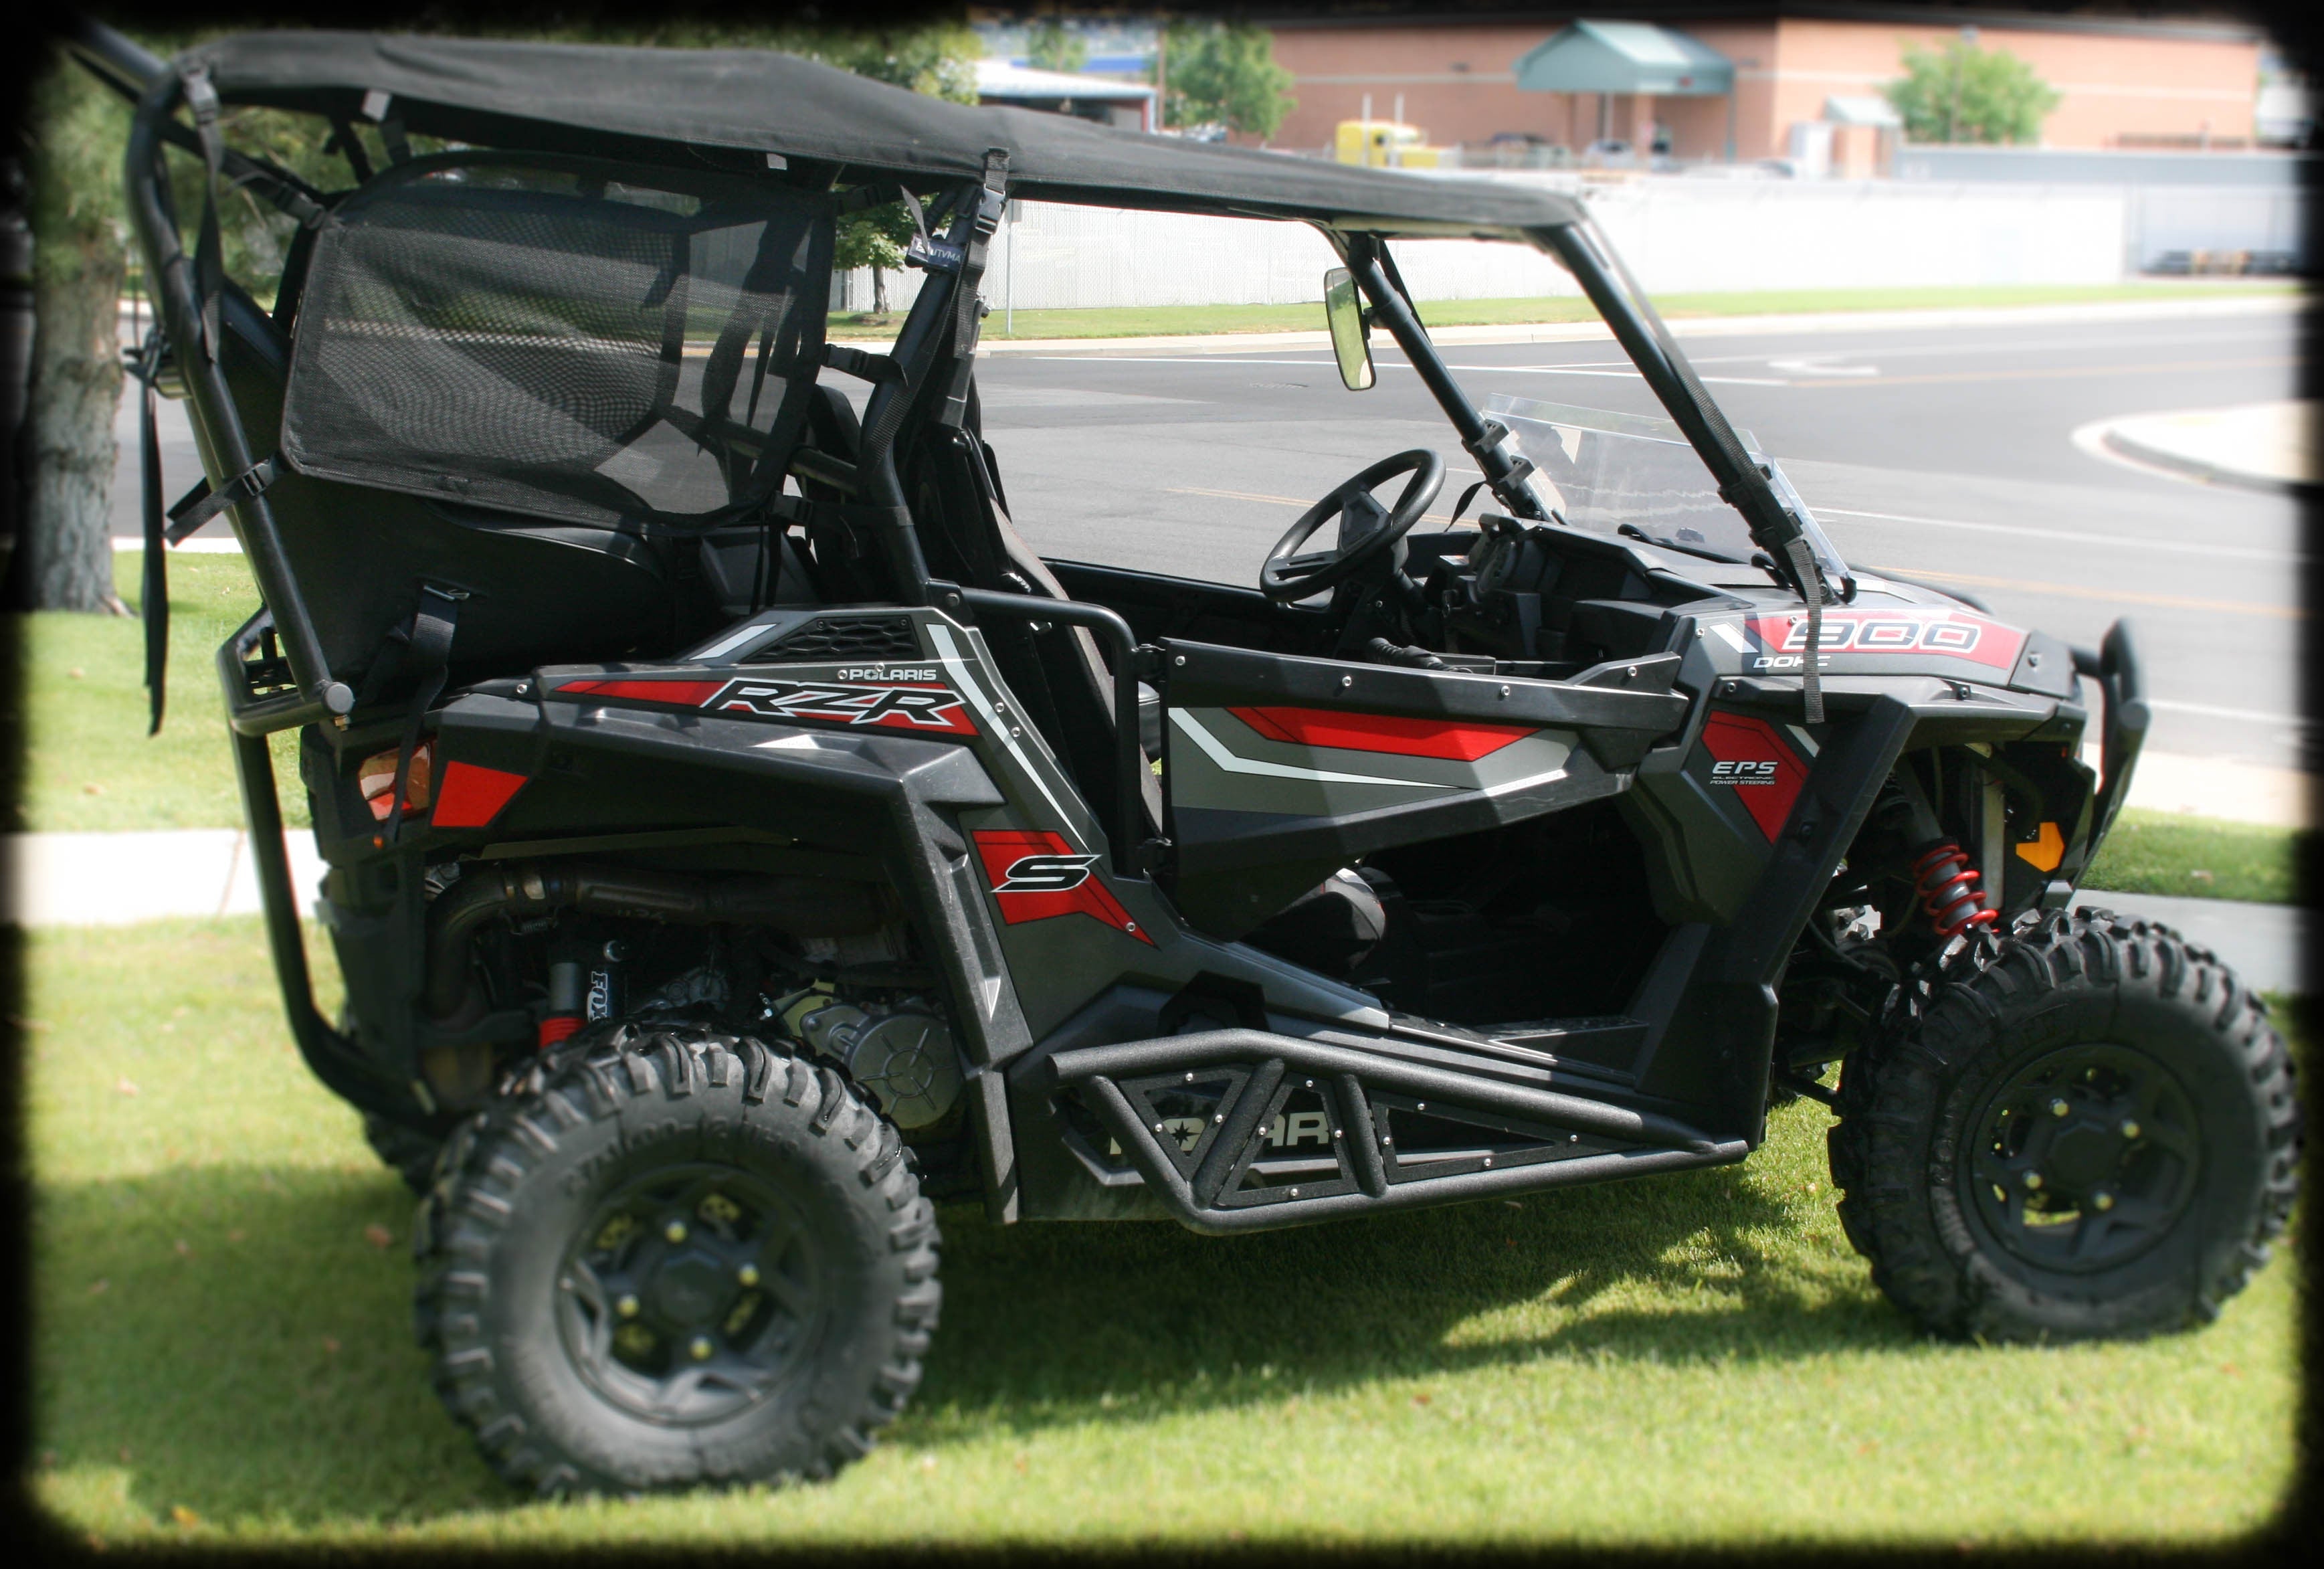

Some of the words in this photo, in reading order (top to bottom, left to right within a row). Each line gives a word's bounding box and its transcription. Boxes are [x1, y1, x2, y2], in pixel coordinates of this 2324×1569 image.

[1781, 619, 1982, 654] 900
[849, 669, 937, 680] POLARIS
[699, 676, 967, 727] RZR
[1712, 761, 1778, 774] EPS
[990, 854, 1102, 893] S
